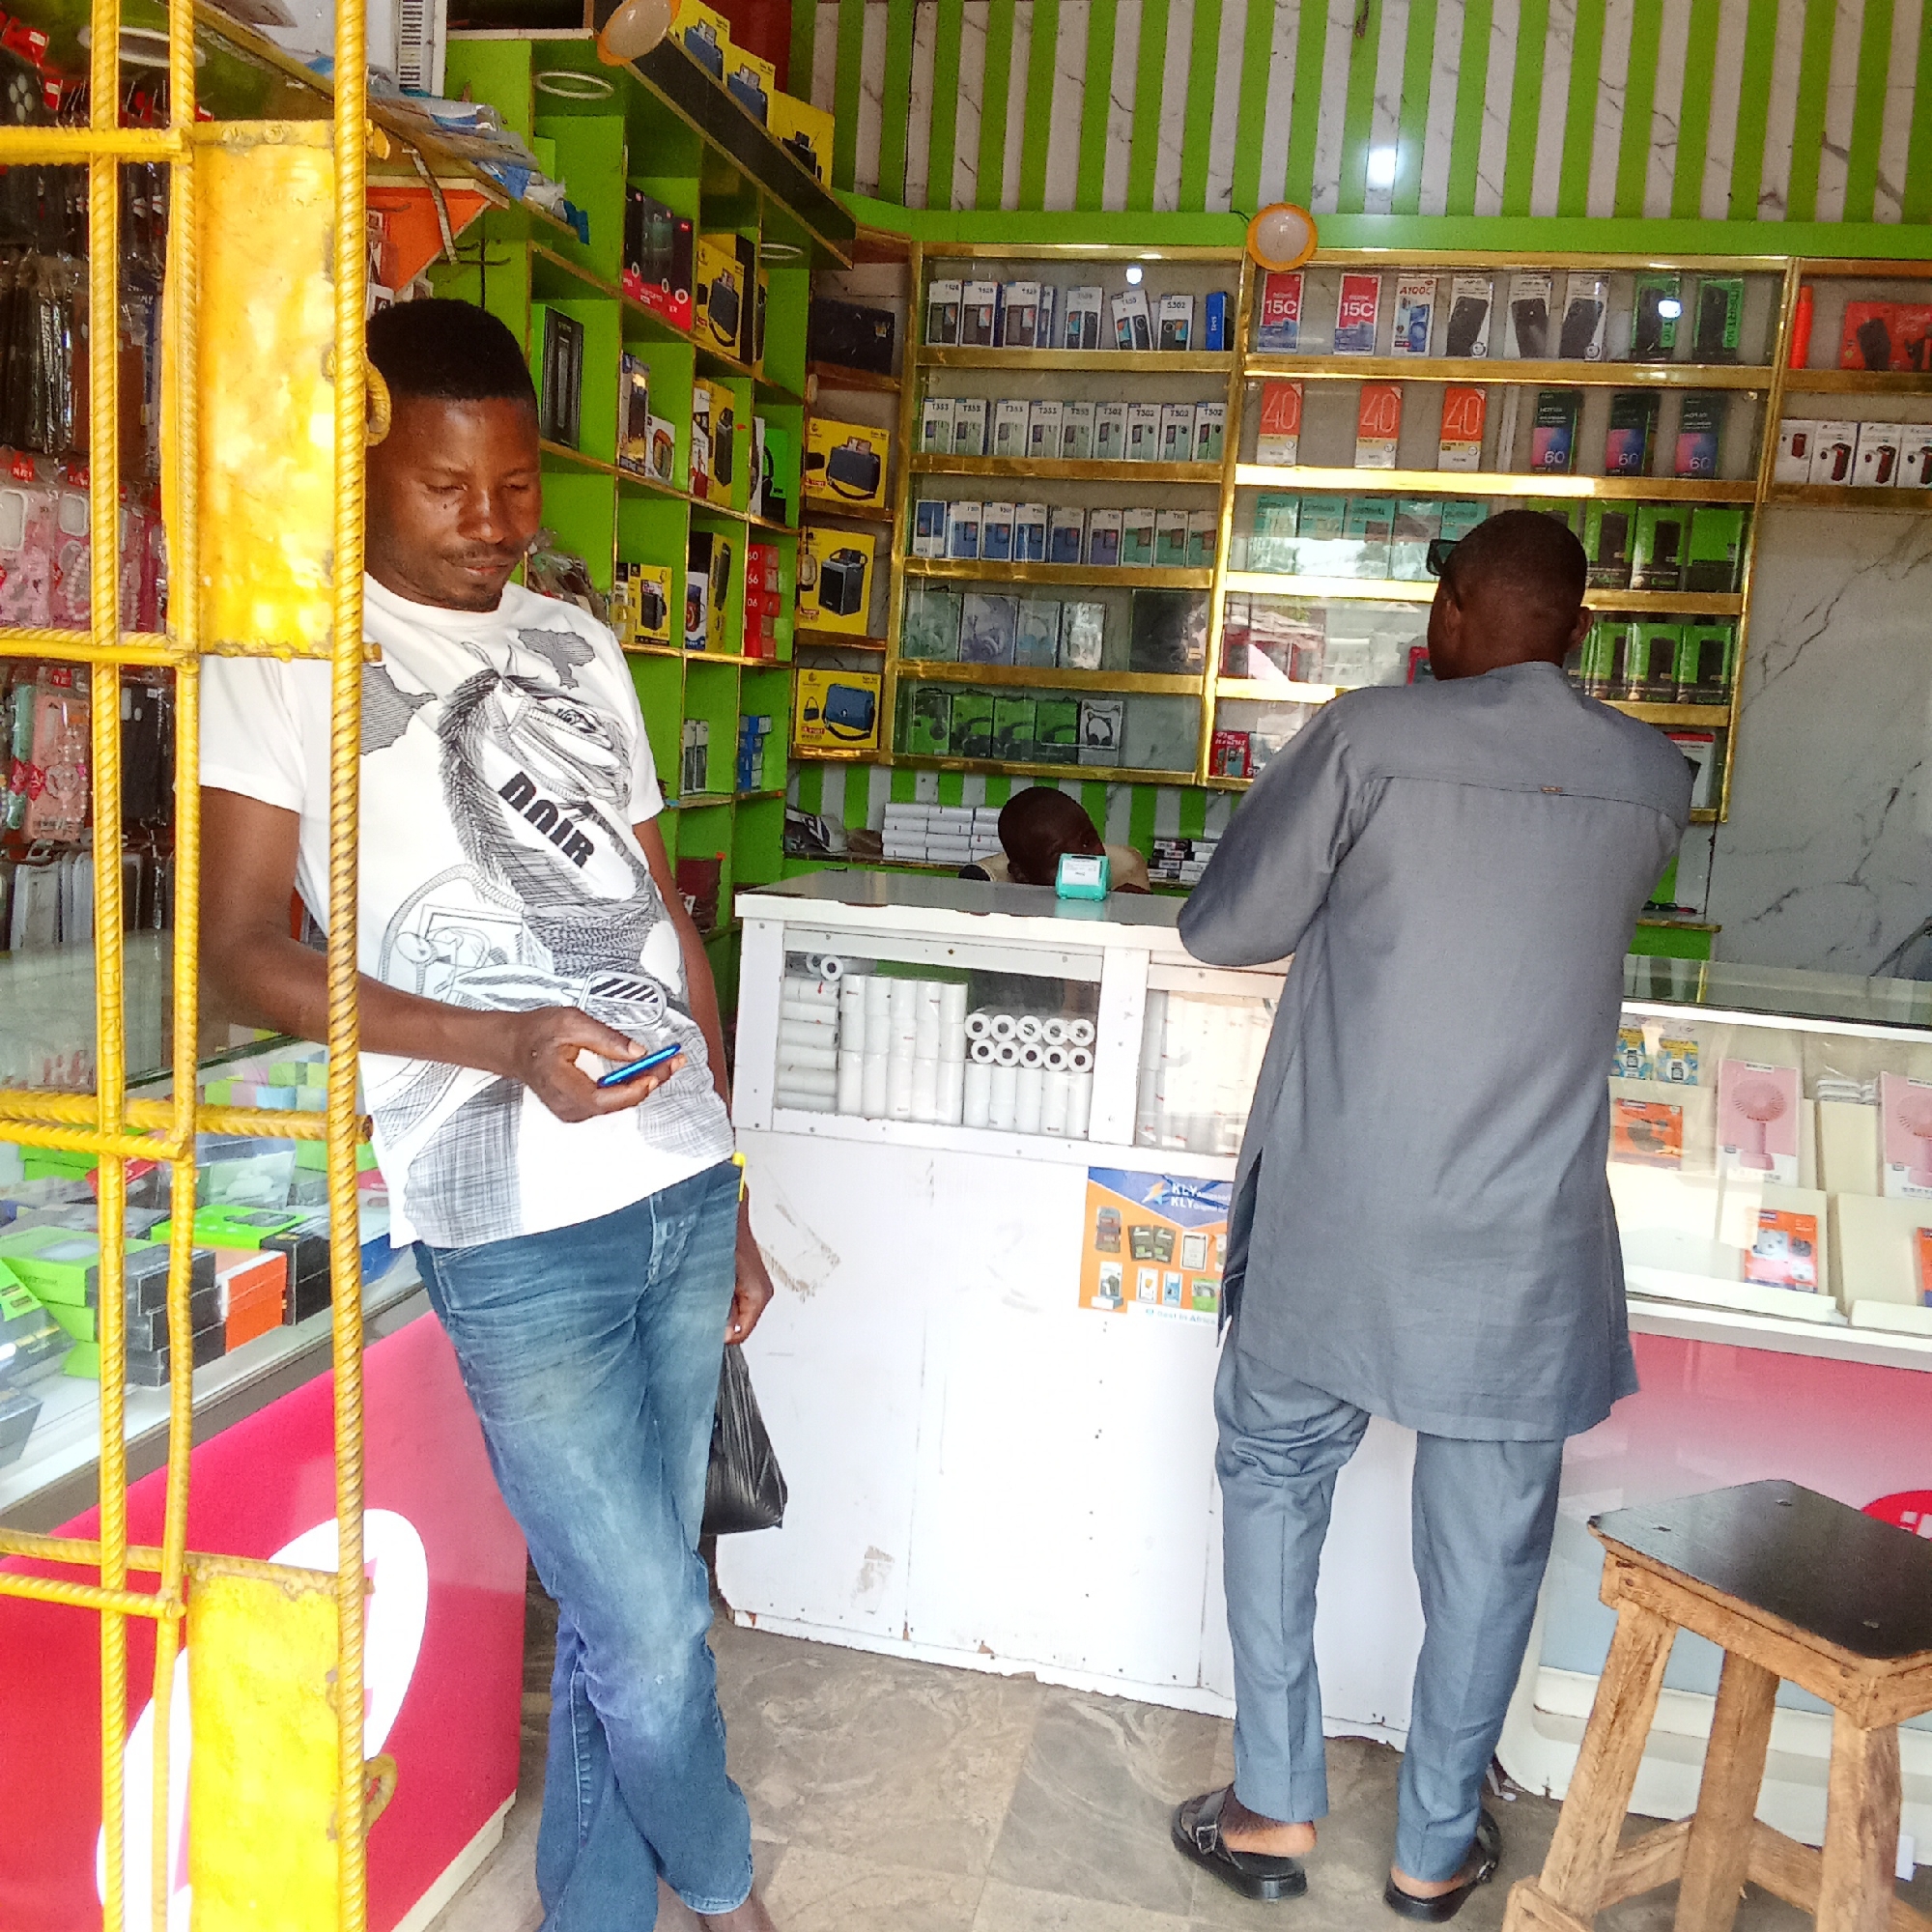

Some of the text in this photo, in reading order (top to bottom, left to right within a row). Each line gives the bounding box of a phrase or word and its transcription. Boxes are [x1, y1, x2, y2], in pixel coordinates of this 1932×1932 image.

[1265, 299, 1297, 315] 15C
[1343, 302, 1375, 318] 15C
[1262, 390, 1298, 430] 40
[1360, 393, 1397, 434] 40
[1445, 396, 1482, 436] 40
[1544, 451, 1565, 464] 60
[1618, 453, 1638, 466] 60
[1172, 1182, 1198, 1197] KLY
[1170, 1196, 1194, 1208] KLY
